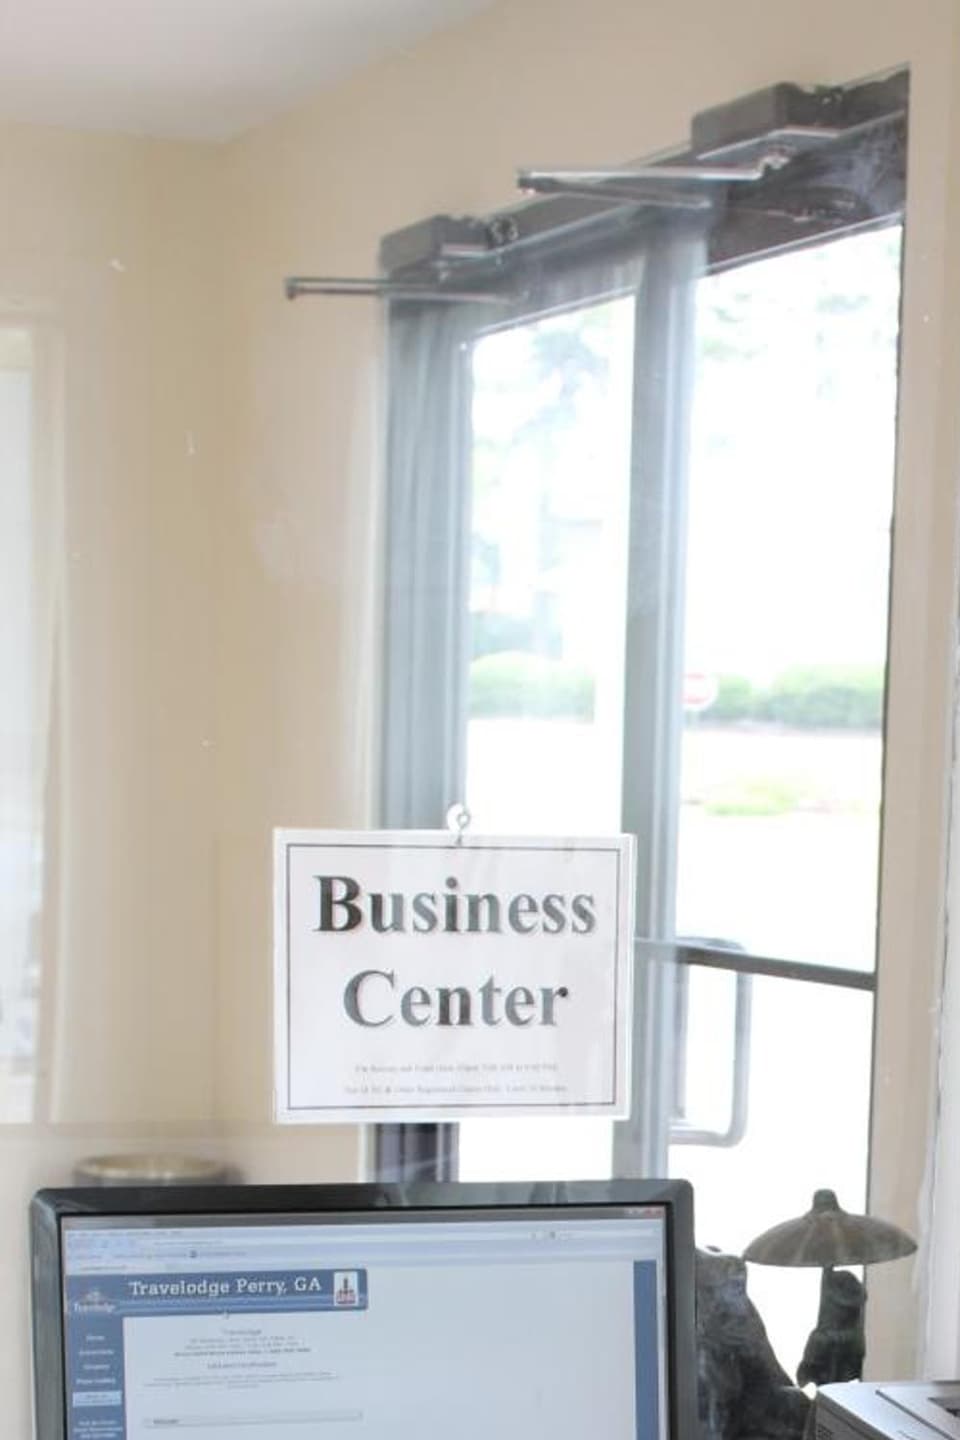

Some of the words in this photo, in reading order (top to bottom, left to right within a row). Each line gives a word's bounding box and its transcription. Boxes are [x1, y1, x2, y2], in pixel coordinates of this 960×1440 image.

[314, 875, 597, 935] Business
[343, 969, 569, 1028] Center
[128, 1279, 230, 1297] Travelodge
[236, 1277, 288, 1296] Perry,
[294, 1277, 323, 1292] GA
